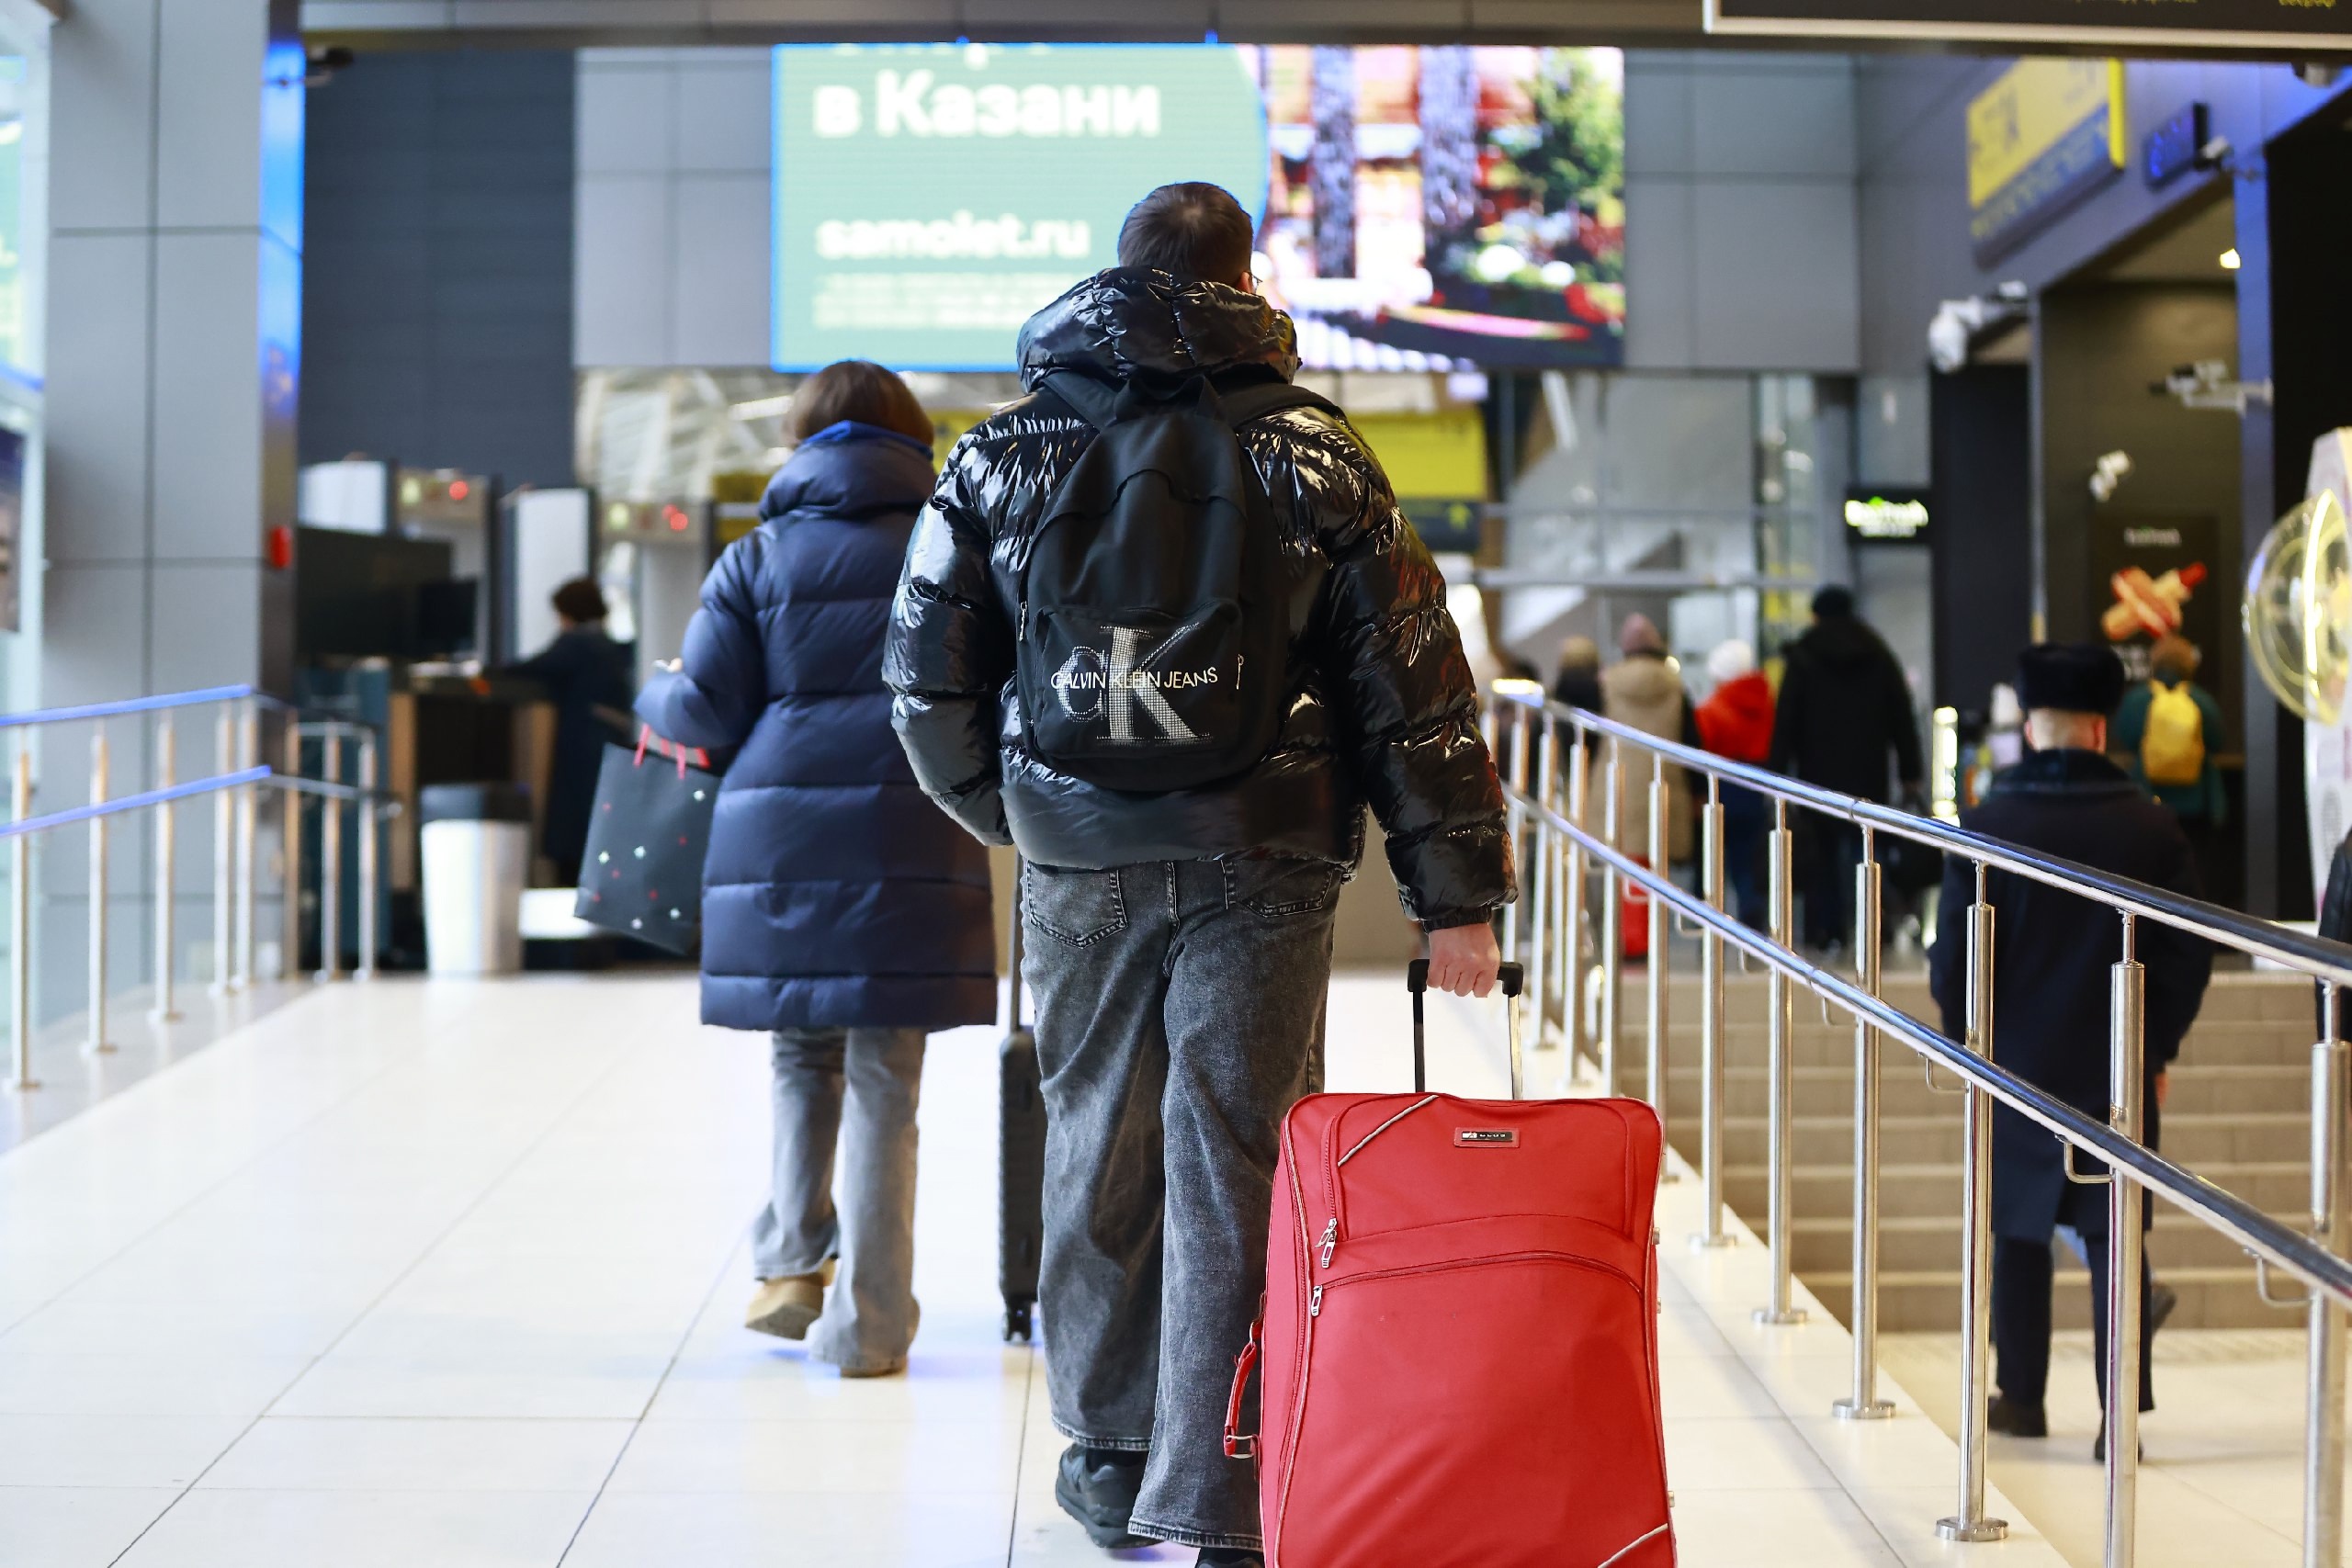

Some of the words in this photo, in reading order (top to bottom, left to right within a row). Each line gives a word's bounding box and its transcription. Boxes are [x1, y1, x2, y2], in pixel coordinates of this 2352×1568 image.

[814, 85, 861, 137] в
[876, 69, 1159, 137] Казани
[816, 210, 1091, 259] samolet.ru
[1050, 671, 1106, 690] CALVIN
[1109, 670, 1160, 689] KLEIN
[1164, 666, 1218, 689] JEANS
